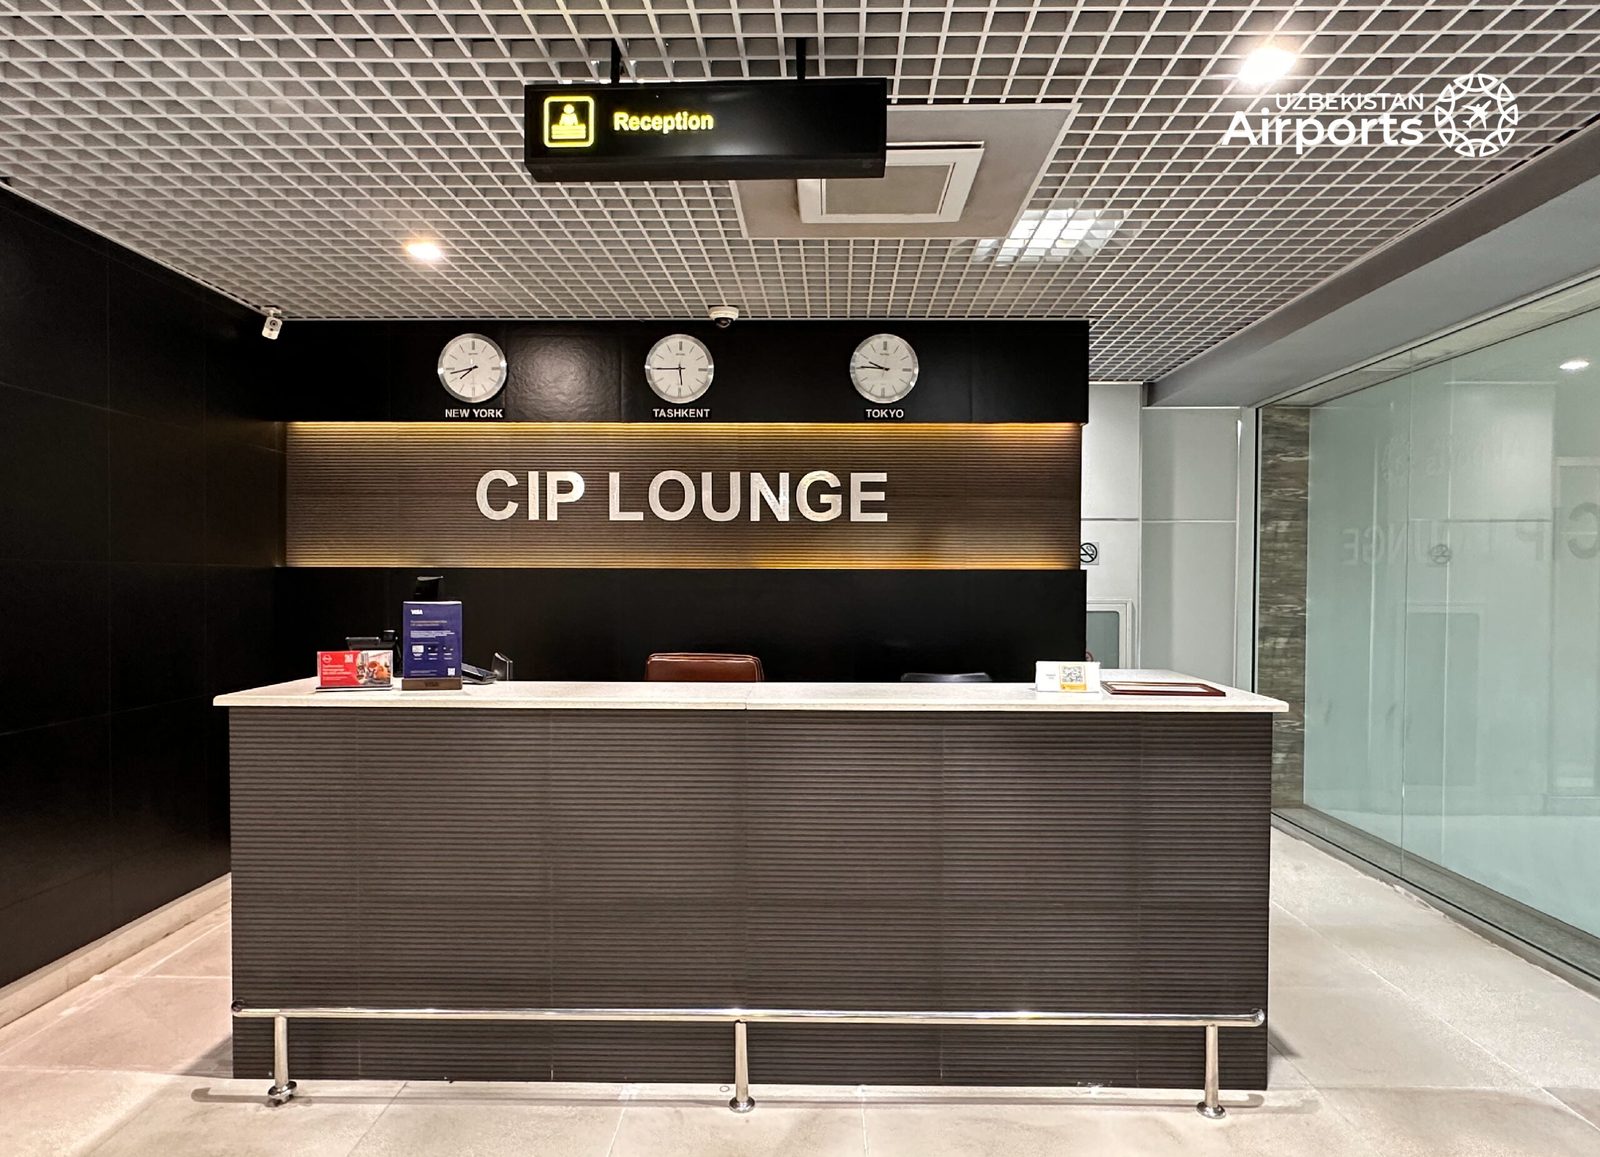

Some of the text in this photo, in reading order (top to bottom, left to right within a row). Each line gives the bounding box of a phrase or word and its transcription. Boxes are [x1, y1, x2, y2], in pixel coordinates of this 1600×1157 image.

[613, 111, 715, 134] Reception
[445, 408, 503, 418] NEW YORK
[652, 408, 710, 418] TASHKENT
[865, 408, 904, 418] TOKYO
[476, 470, 888, 522] CIP LOUNGE
